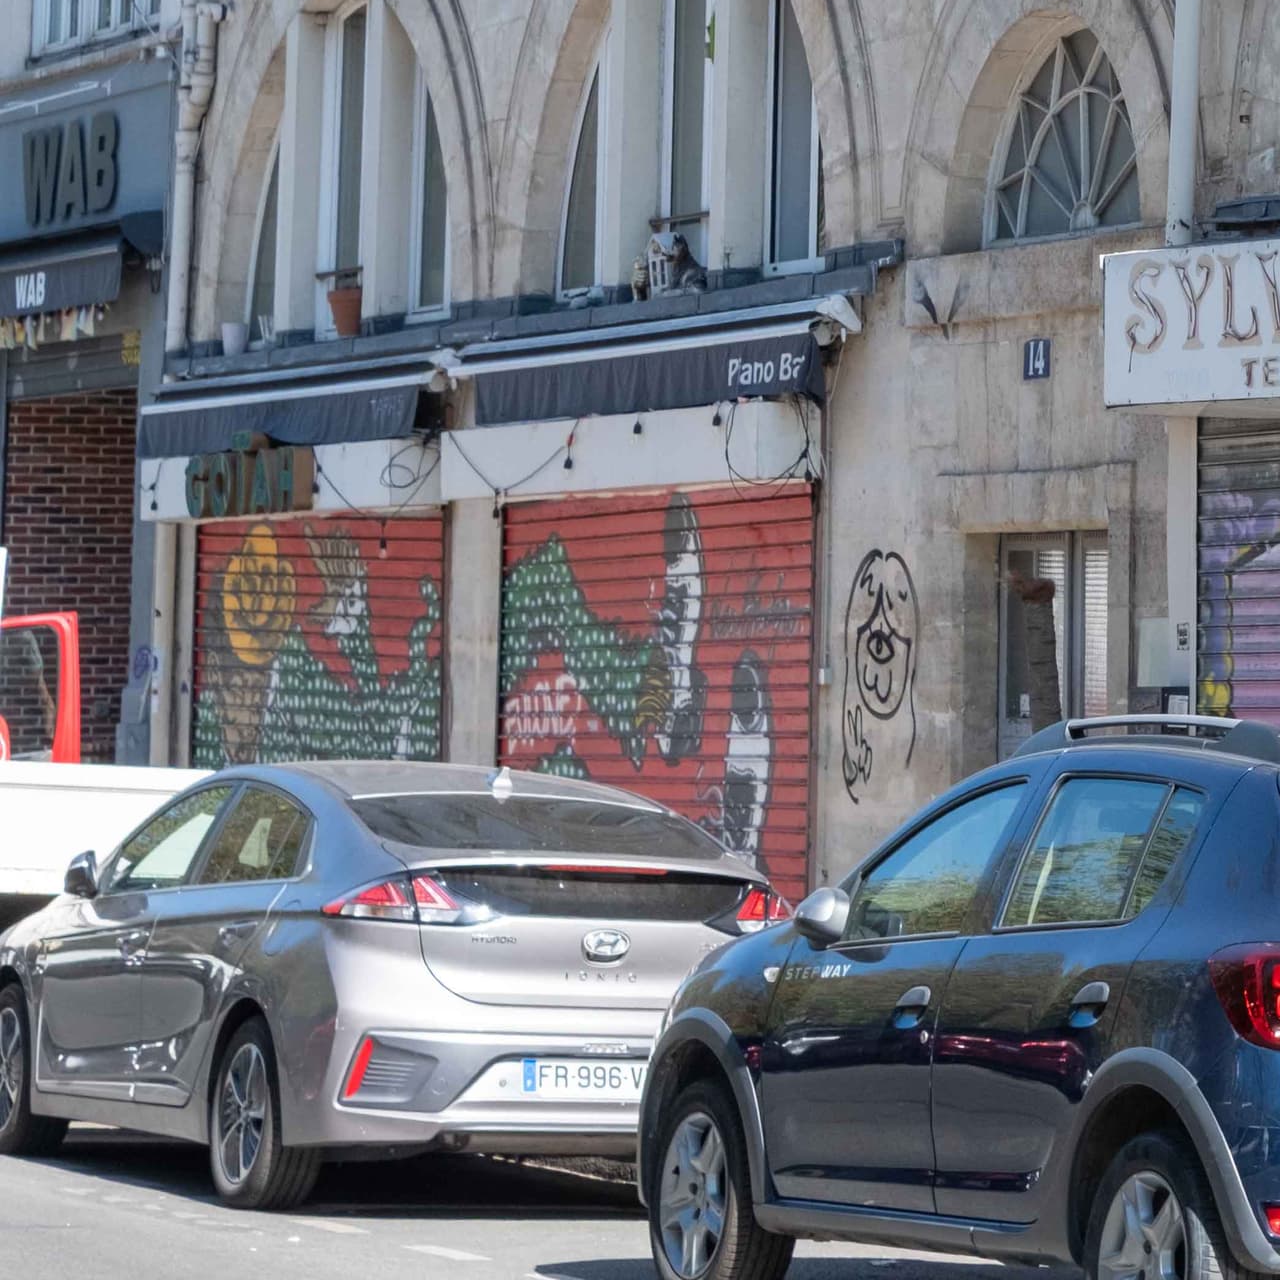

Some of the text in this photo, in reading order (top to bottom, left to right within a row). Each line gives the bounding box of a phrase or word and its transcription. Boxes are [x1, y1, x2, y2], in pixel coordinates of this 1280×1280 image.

[22, 111, 119, 228] WAB
[15, 272, 46, 309] WAB
[728, 357, 774, 386] Pano
[1028, 340, 1045, 376] 14
[784, 964, 852, 981] STEPWAY
